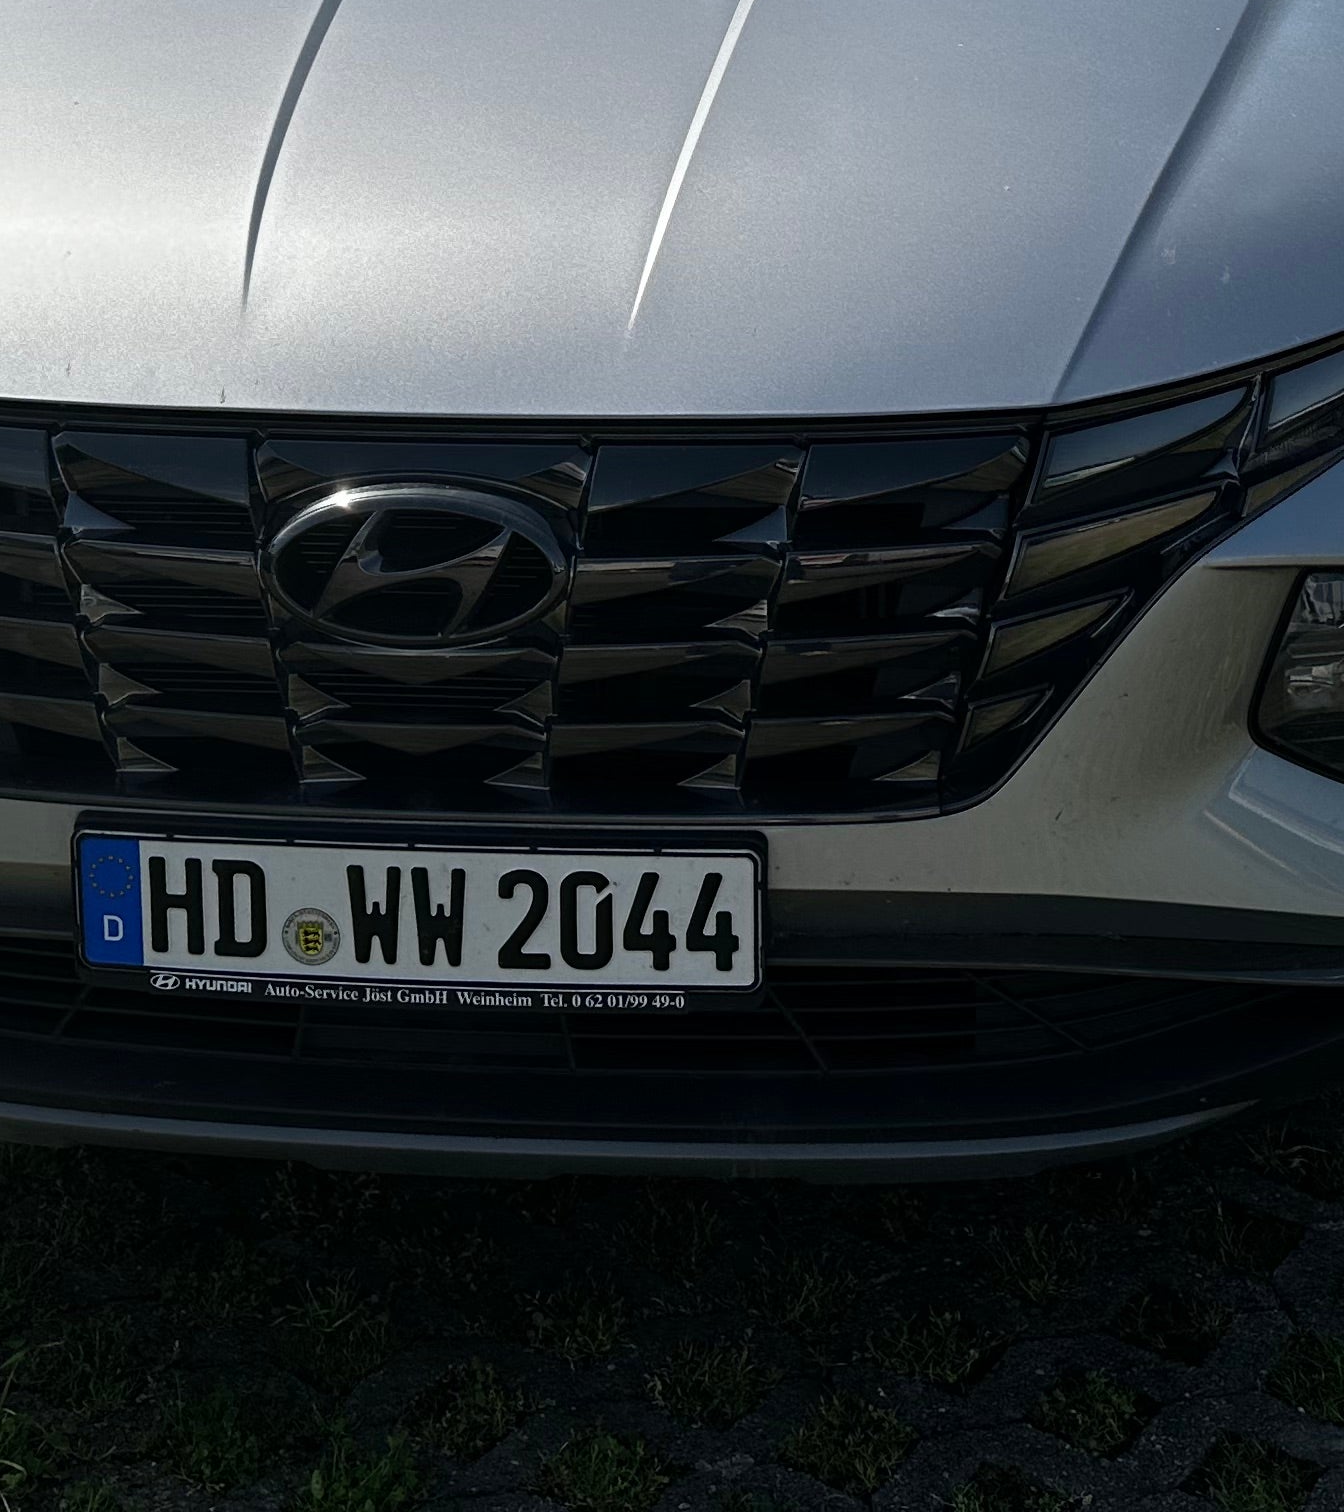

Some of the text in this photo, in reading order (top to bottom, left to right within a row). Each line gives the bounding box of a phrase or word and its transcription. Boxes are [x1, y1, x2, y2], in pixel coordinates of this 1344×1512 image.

[148, 855, 268, 958] HD
[346, 864, 467, 967] WW
[497, 868, 740, 972] 2044
[103, 914, 124, 942] D
[184, 977, 253, 994] HYUNDAI
[264, 983, 685, 1010] Auto-Service Jöst GmbH Weinheim Tel. 0 62 01/99 49-0
